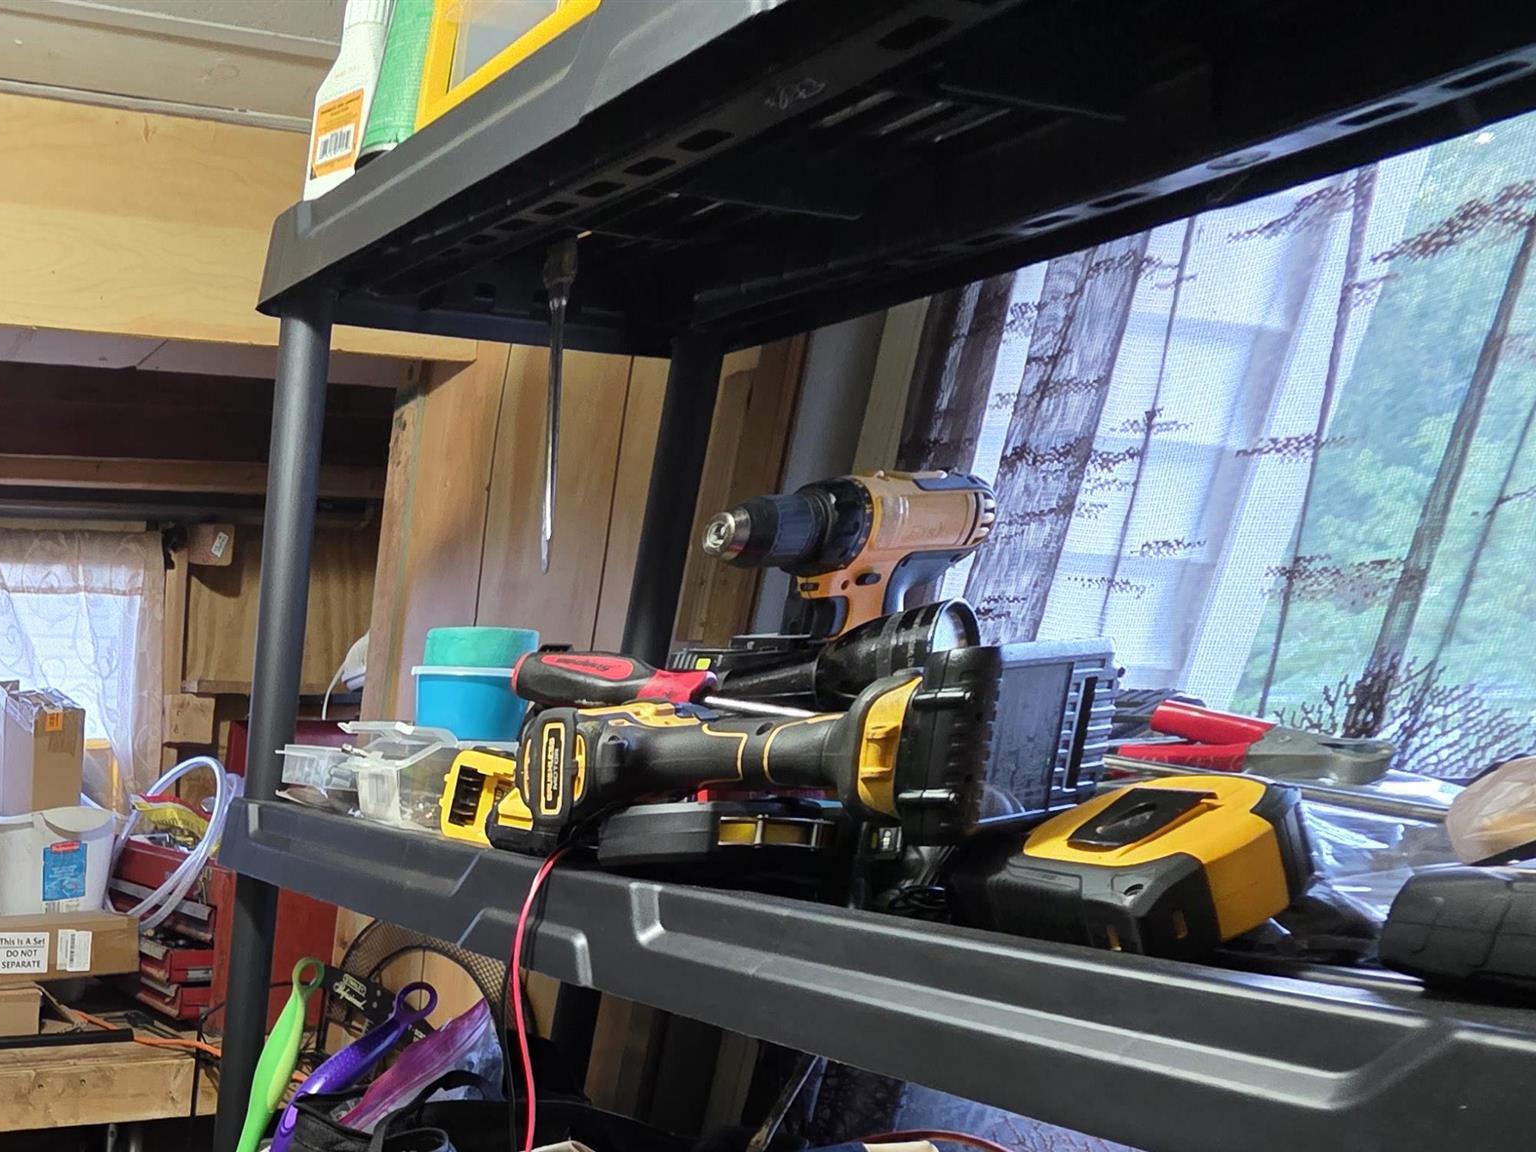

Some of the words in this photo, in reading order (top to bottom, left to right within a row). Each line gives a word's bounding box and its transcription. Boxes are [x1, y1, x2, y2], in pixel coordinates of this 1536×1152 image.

[0, 937, 15, 946] This
[17, 937, 23, 946] Is
[25, 937, 31, 945] A
[33, 937, 46, 945] Set
[20, 949, 38, 957] NOT
[1, 960, 41, 969] SEPARATE
